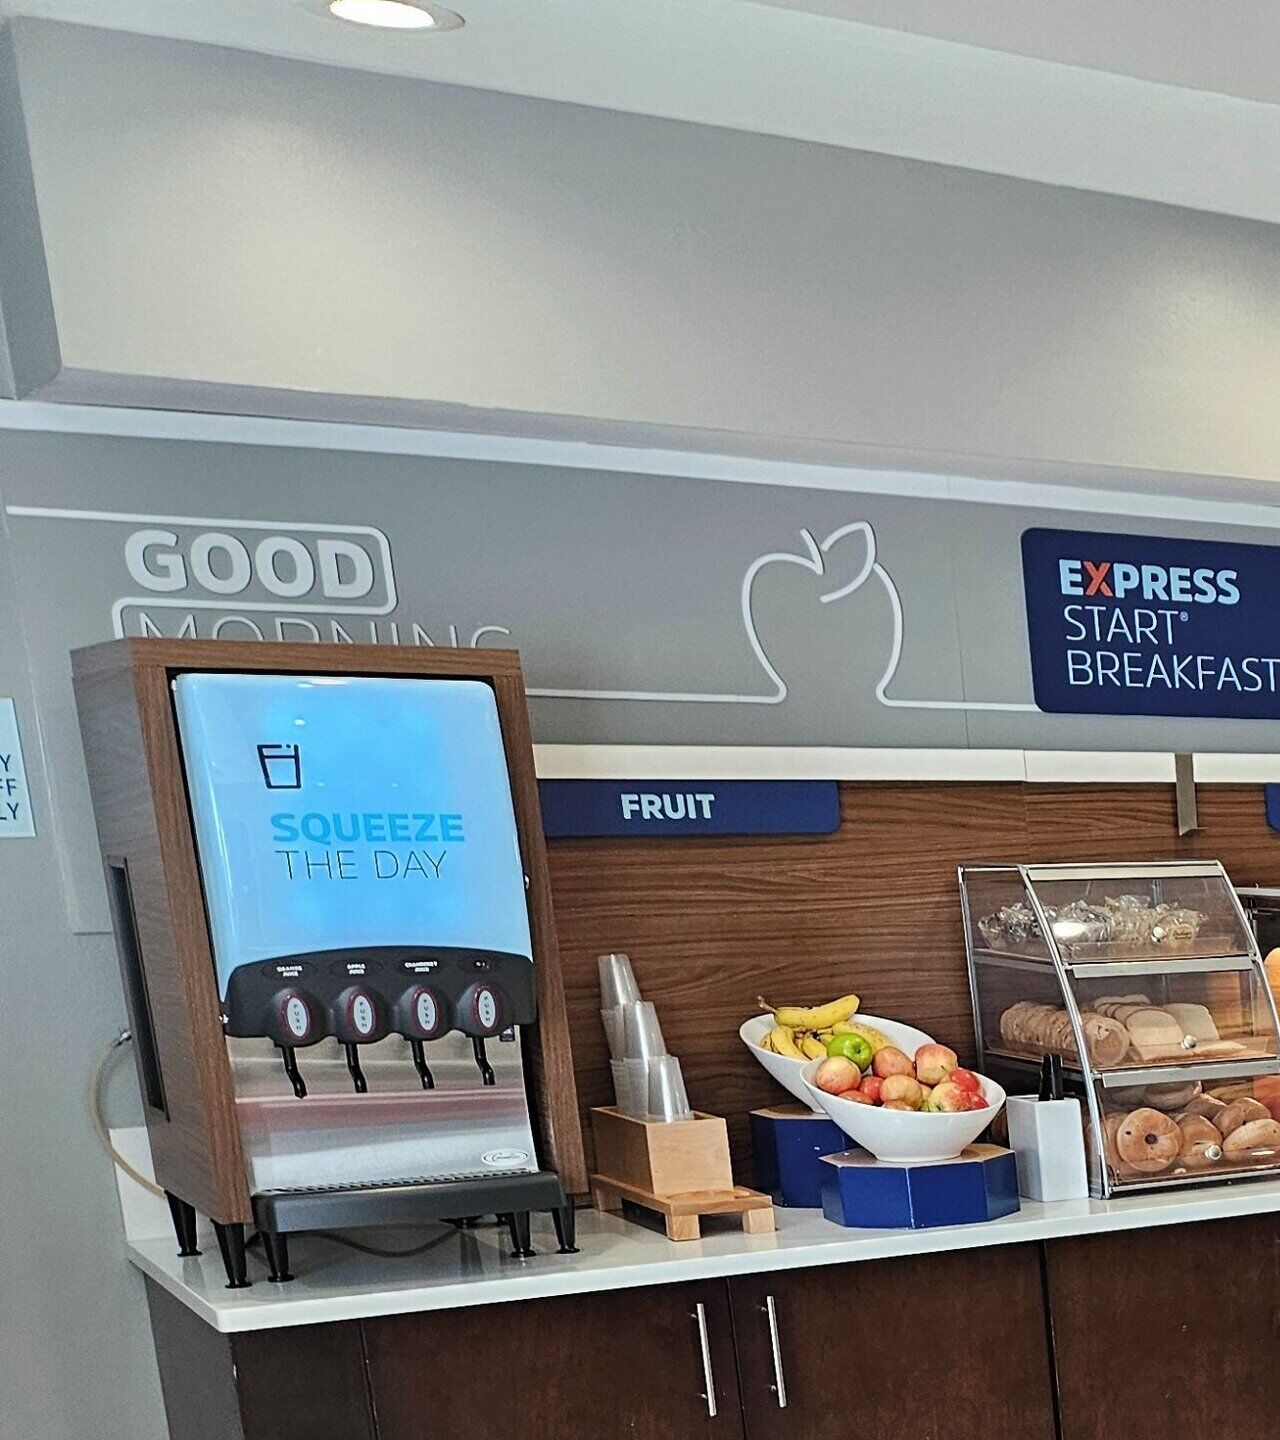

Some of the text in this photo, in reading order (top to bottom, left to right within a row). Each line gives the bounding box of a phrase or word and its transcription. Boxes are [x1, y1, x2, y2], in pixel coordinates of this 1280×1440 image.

[125, 529, 374, 599] GOOD
[1058, 558, 1241, 605] EXPRESS
[620, 793, 715, 820] FRUIT
[270, 812, 466, 846] SQUEEZE
[275, 850, 447, 880] THE DAY
